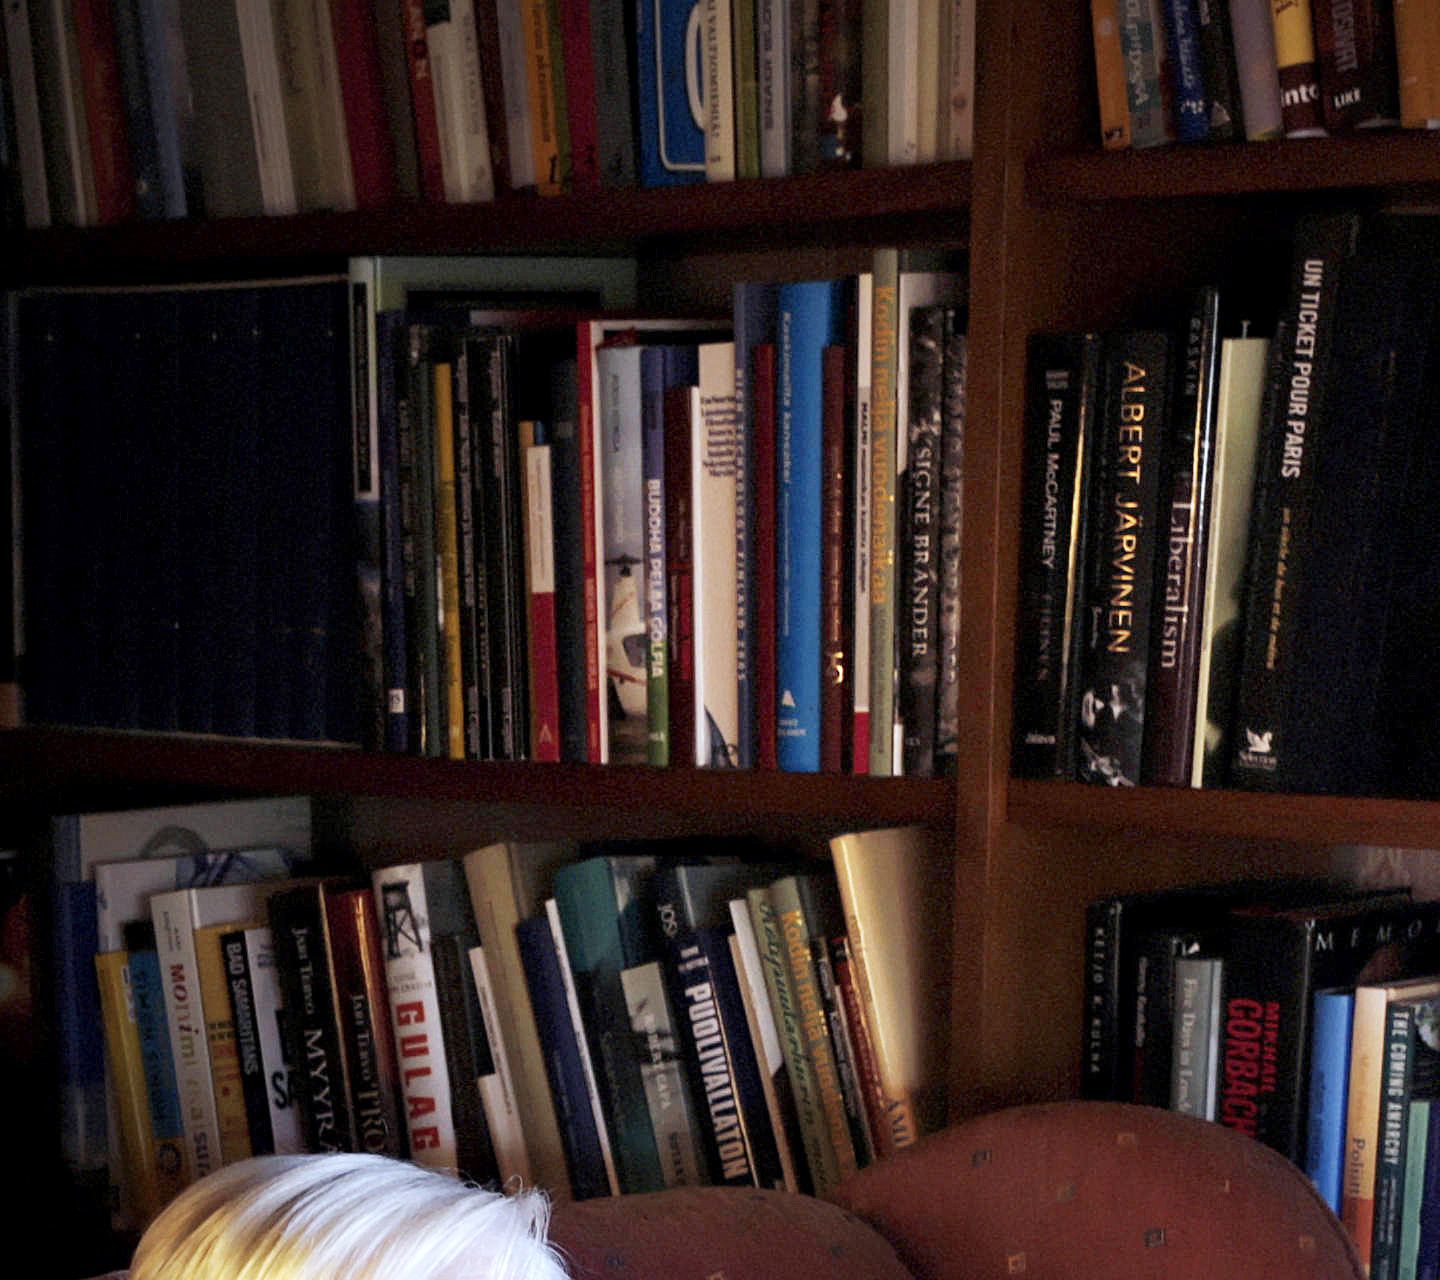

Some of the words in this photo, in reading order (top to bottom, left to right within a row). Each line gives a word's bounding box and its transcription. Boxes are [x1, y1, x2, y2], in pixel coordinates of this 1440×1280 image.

[1303, 258, 1321, 288] UN
[873, 287, 893, 360] Kodin
[1296, 290, 1318, 357] TICKET
[1049, 398, 1064, 449] PAUL
[1119, 360, 1147, 484] ALBERT
[1290, 361, 1310, 417] POUR
[913, 447, 931, 525] SIGNE
[1283, 420, 1304, 478] PARIS
[646, 479, 661, 555] BUDDHA
[1041, 453, 1061, 570] McCARTNEY
[911, 534, 931, 658] BRANDER
[1107, 492, 1142, 655] JÄRVINEN
[1160, 498, 1192, 670] Liberalism
[650, 617, 666, 677] GOLFIA
[225, 941, 246, 974] BAD
[233, 977, 264, 1074] SAMARITANS
[1258, 1001, 1281, 1092] MIKHAIL
[1391, 1010, 1411, 1037] THE
[395, 1002, 441, 1154] GULAG
[685, 982, 748, 1180] PUOLIVALLATON
[1388, 1042, 1409, 1096] COMING
[1383, 1101, 1406, 1165] ANARCHY
